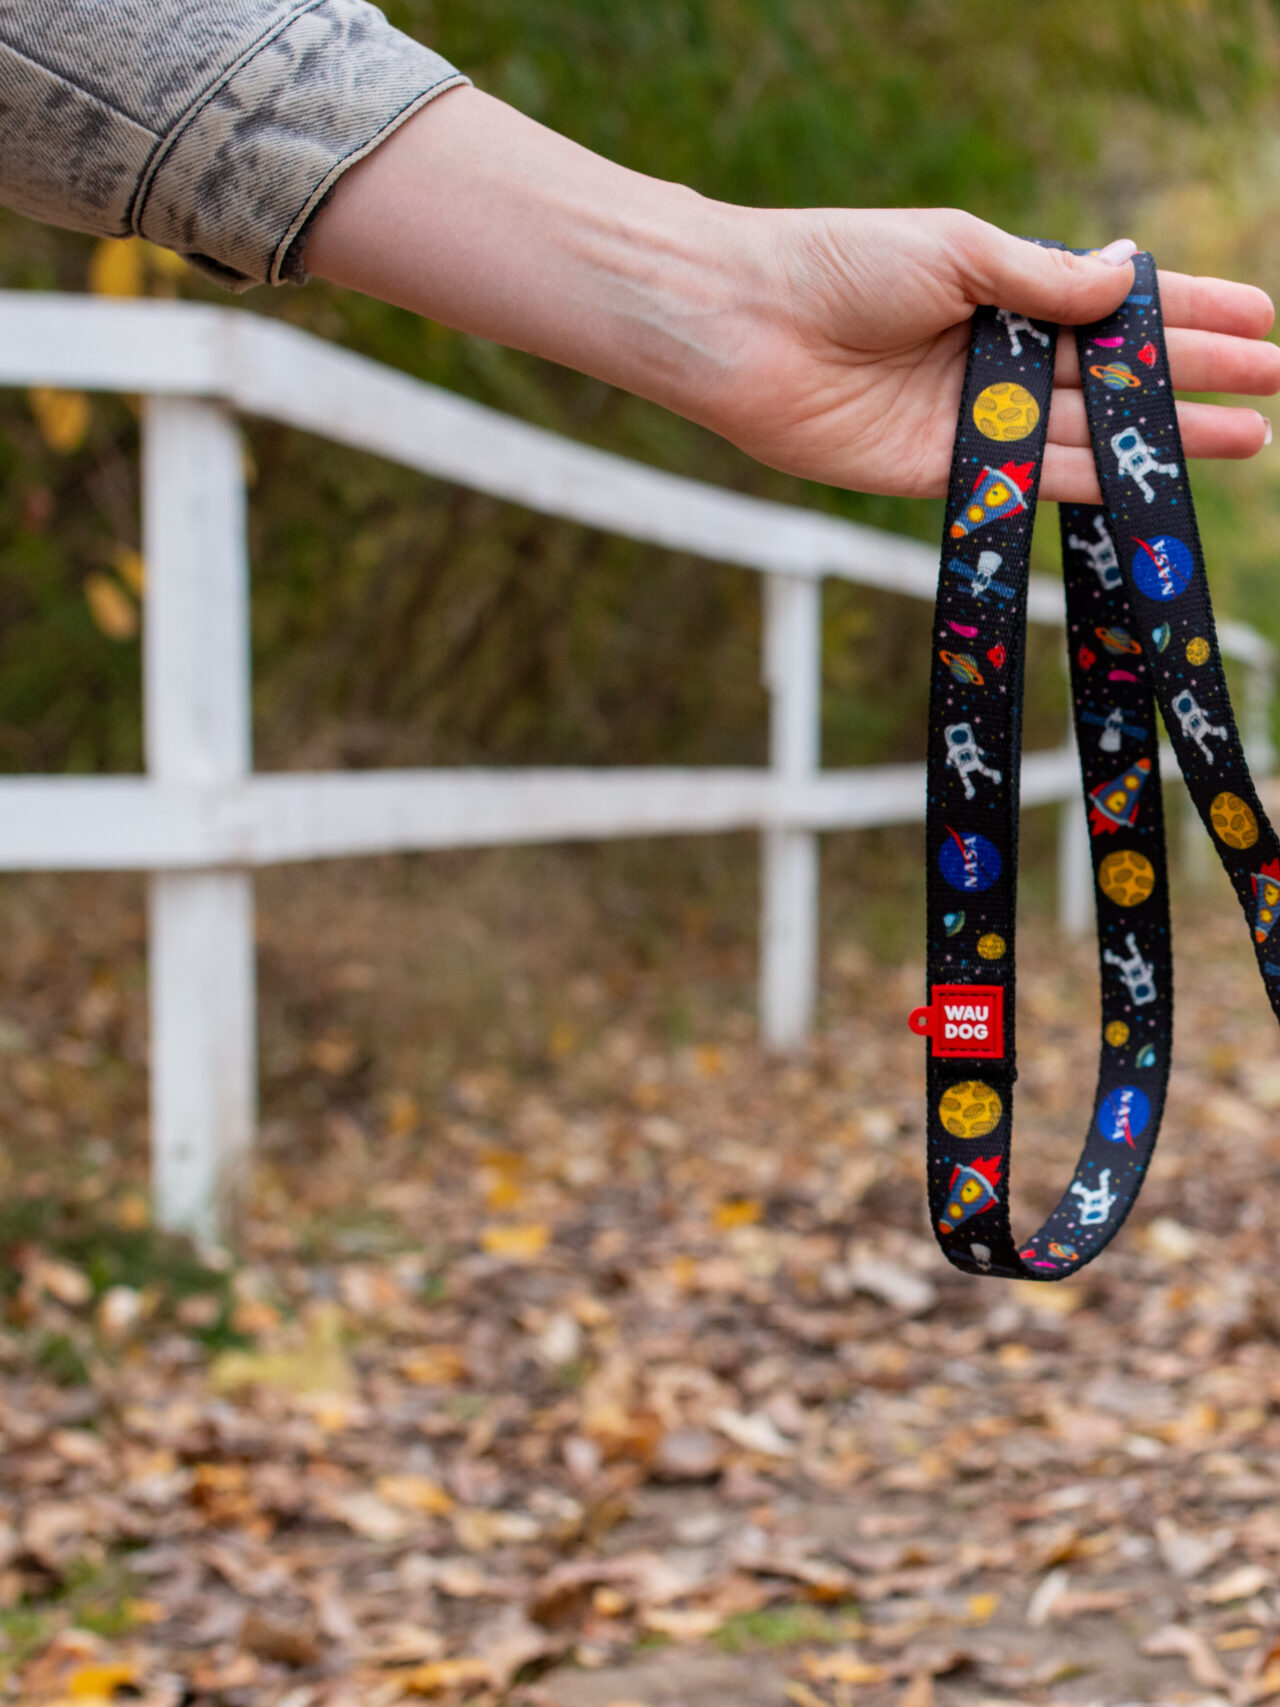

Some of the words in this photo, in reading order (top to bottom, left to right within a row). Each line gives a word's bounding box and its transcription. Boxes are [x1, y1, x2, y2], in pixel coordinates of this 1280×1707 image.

[1152, 539, 1175, 596] NASA
[963, 835, 978, 887] NASA
[943, 1004, 989, 1022] WAU
[944, 1022, 989, 1041] DOG
[1111, 1090, 1134, 1140] NASA
